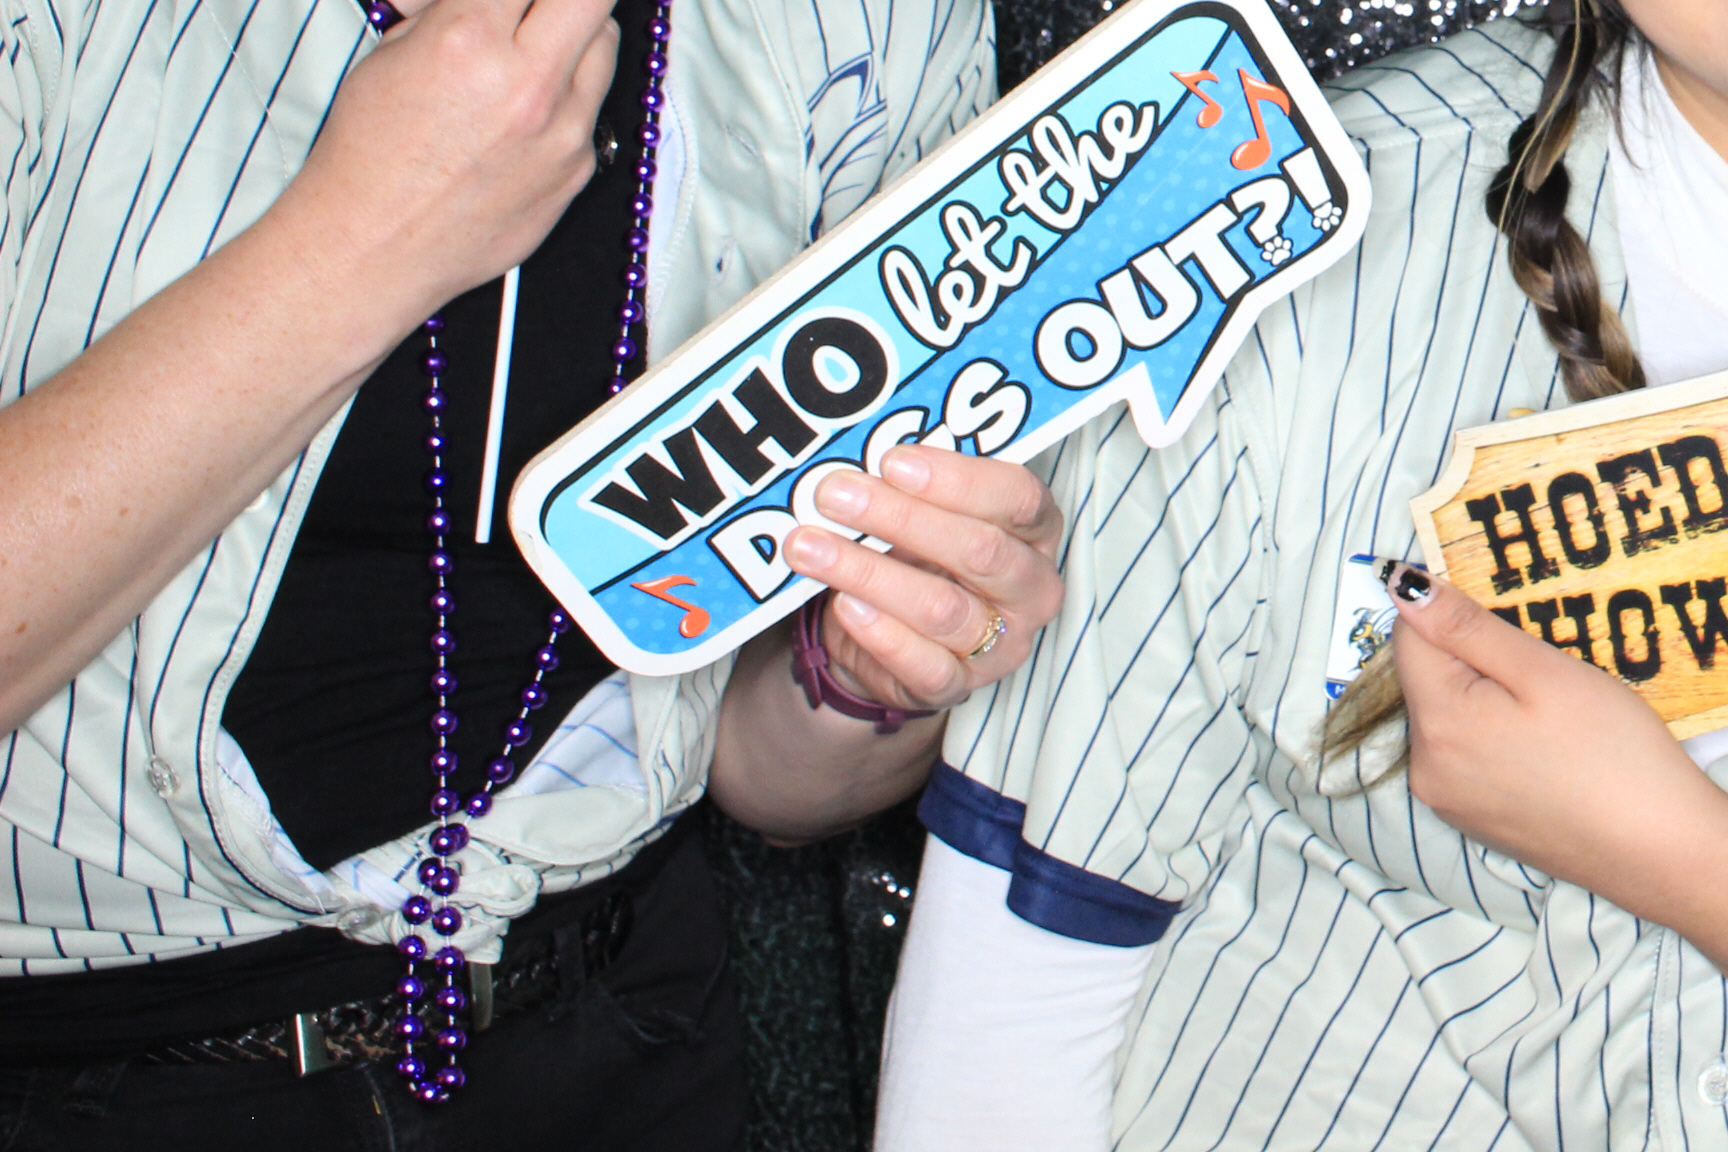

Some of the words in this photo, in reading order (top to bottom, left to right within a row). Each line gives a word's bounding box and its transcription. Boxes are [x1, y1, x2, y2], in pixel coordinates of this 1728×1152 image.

[593, 316, 889, 542] WHO
[879, 199, 1034, 351] let
[999, 99, 1160, 234] the
